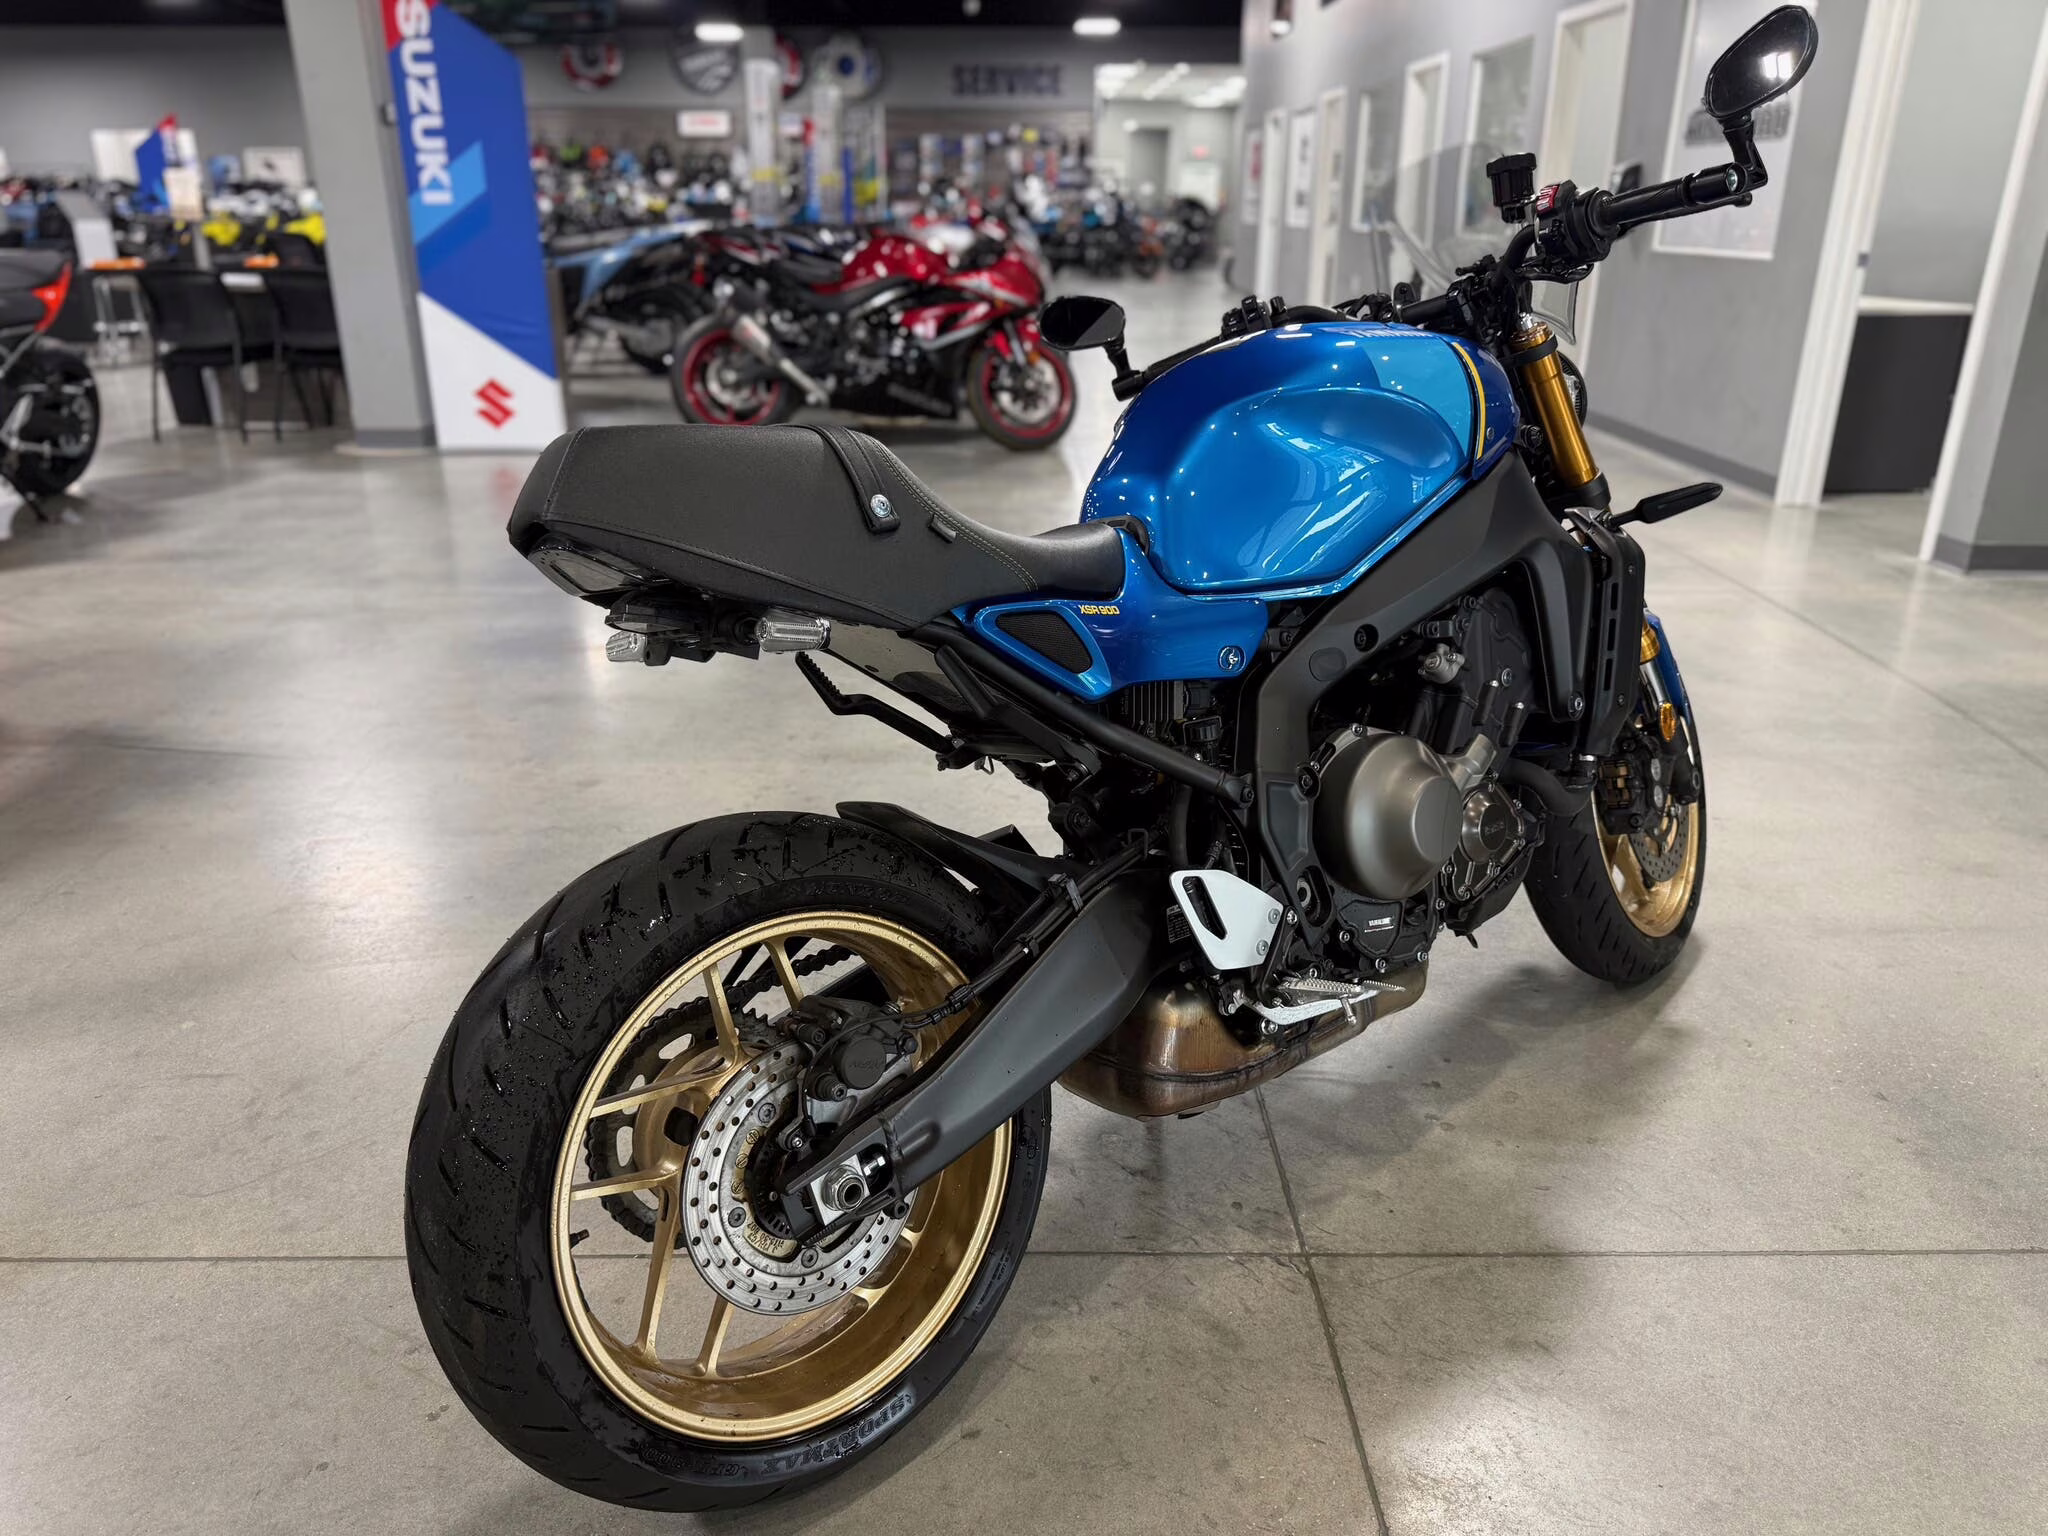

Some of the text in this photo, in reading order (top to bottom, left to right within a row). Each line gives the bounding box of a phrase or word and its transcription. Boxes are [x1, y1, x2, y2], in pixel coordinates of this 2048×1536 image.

[395, 0, 453, 206] SUZUKI
[1078, 604, 1120, 615] XSR 900
